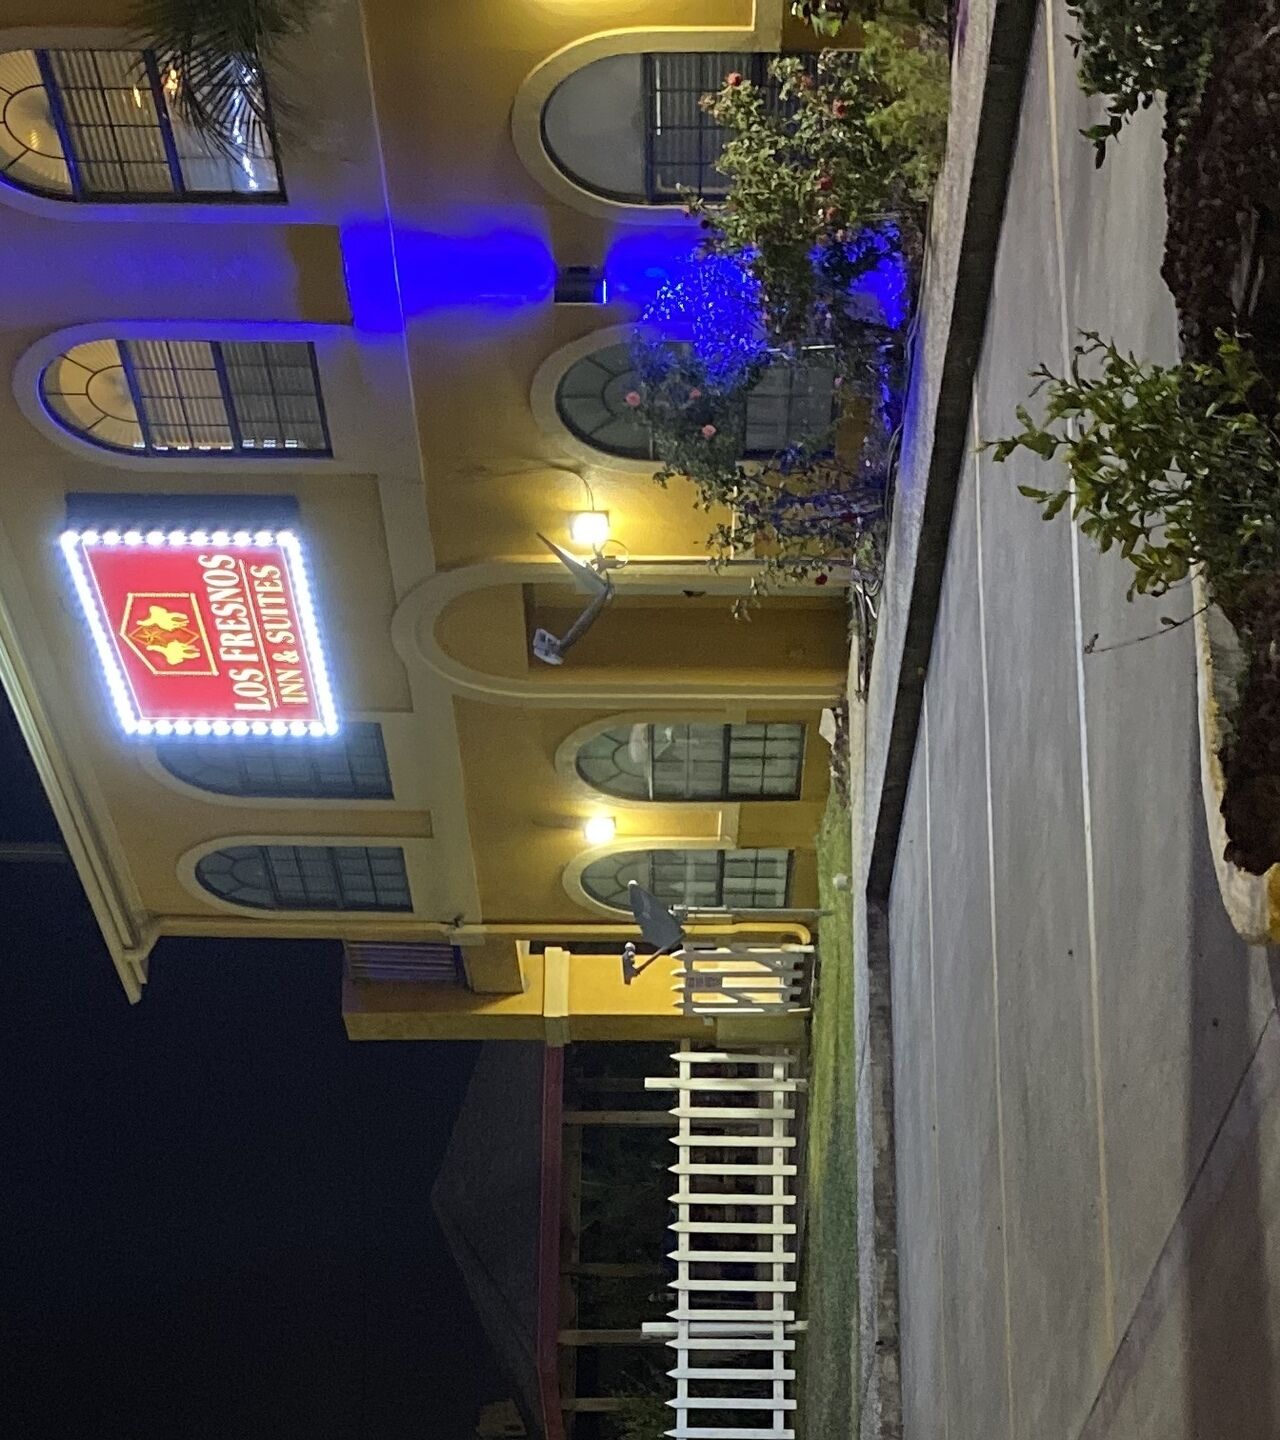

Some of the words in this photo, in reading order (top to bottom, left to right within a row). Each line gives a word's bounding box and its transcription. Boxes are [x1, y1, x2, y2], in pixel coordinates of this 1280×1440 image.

[198, 554, 260, 662] FRESNOS
[250, 564, 296, 644] SUITES
[272, 647, 300, 664] &
[228, 668, 271, 712] LOS
[278, 669, 309, 705] INN
